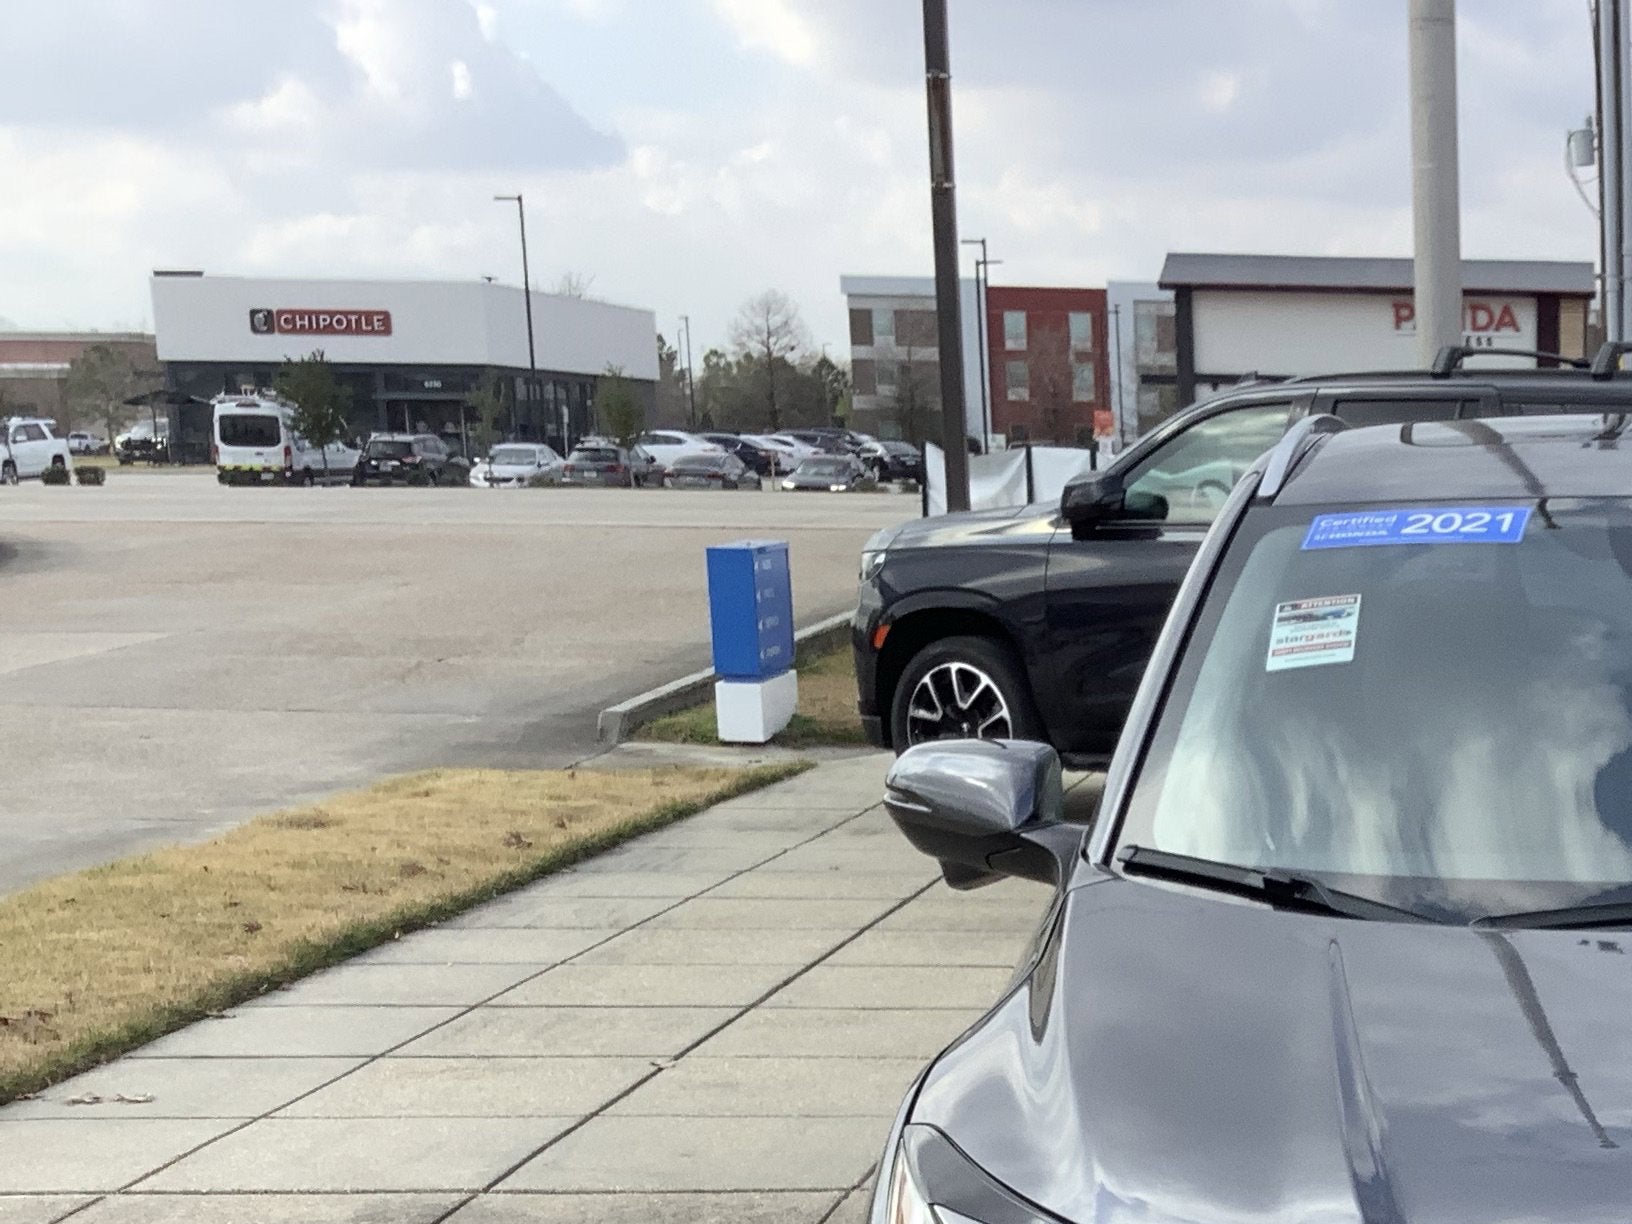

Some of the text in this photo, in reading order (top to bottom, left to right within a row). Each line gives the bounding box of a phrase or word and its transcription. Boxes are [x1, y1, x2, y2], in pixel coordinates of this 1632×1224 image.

[280, 315, 386, 331] CHIPOTLE
[1392, 303, 1520, 333] PDA
[1400, 512, 1514, 535] 2021
